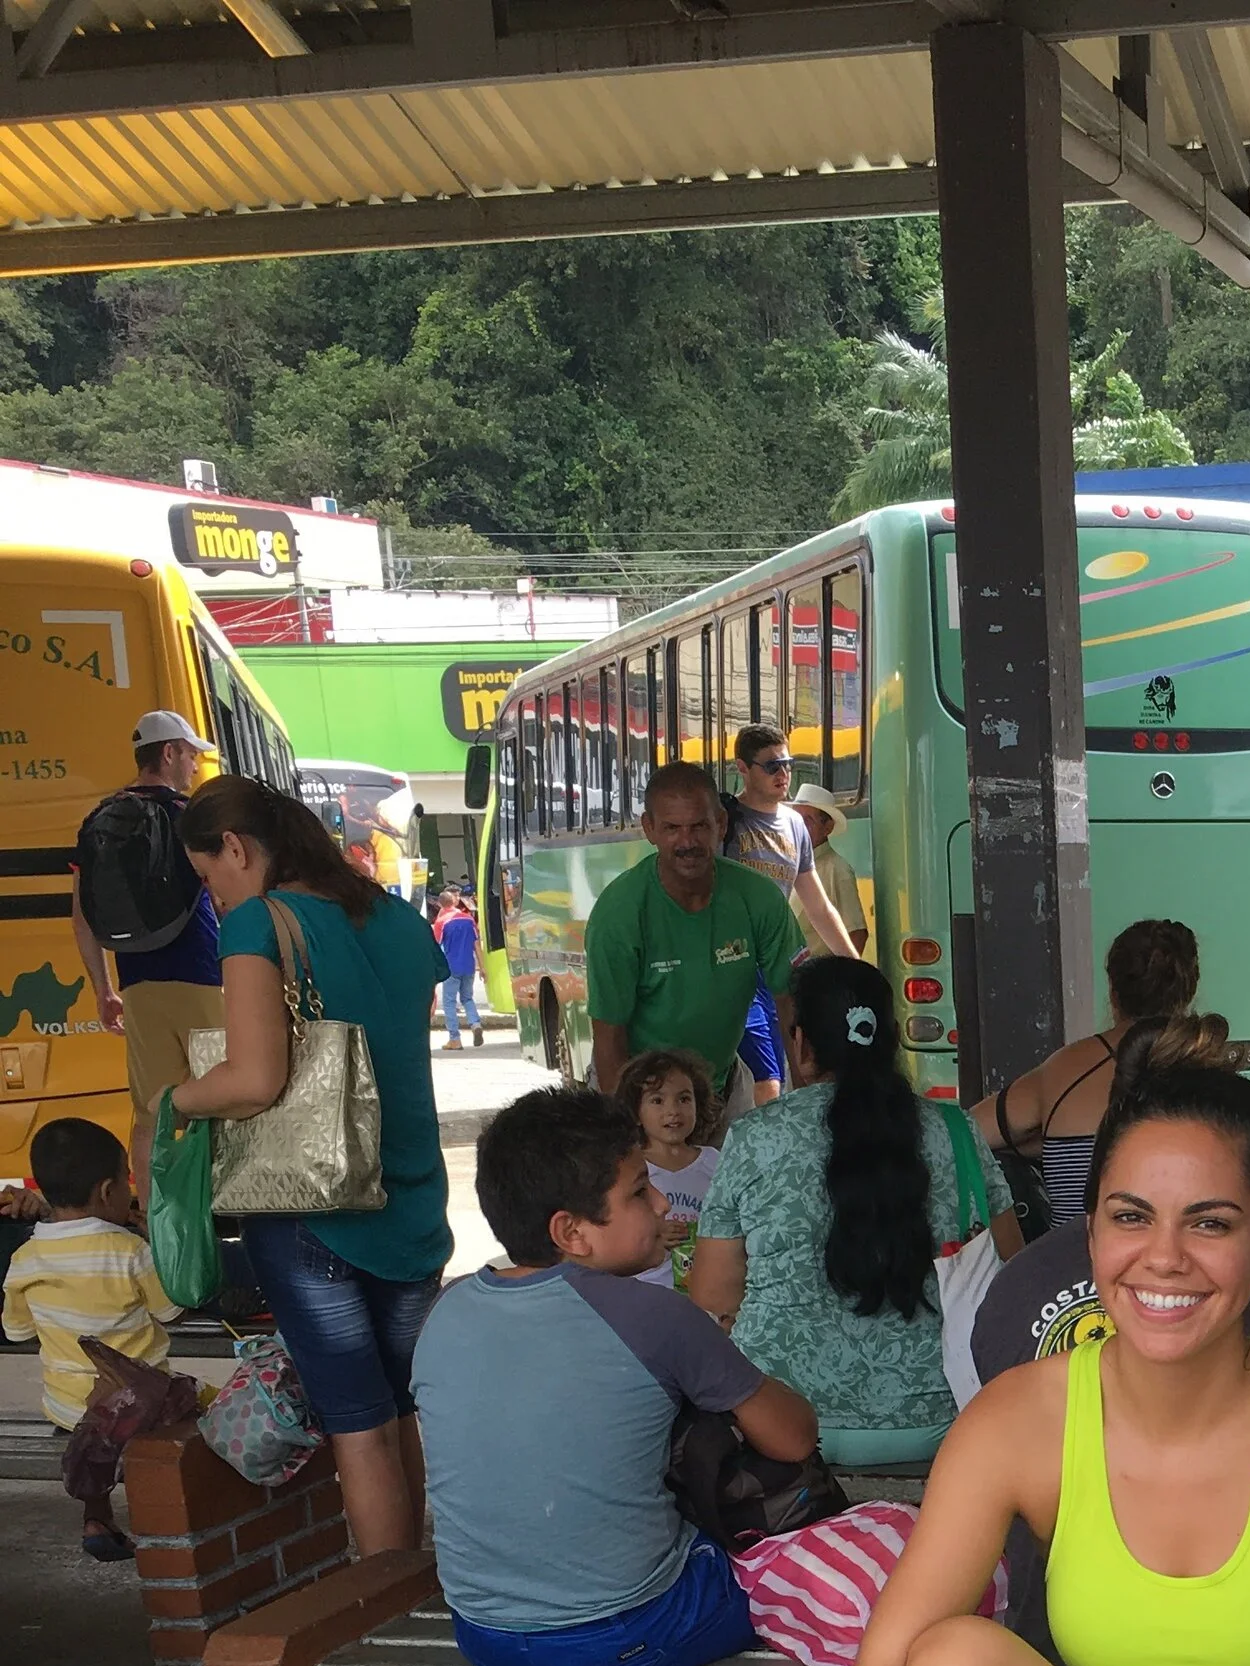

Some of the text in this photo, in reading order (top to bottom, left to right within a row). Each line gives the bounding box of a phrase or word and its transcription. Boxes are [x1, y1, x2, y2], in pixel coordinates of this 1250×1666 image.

[192, 509, 238, 524] Importadora
[195, 525, 290, 575] monge
[43, 635, 114, 686] S.A.
[1, 759, 67, 780] -1455
